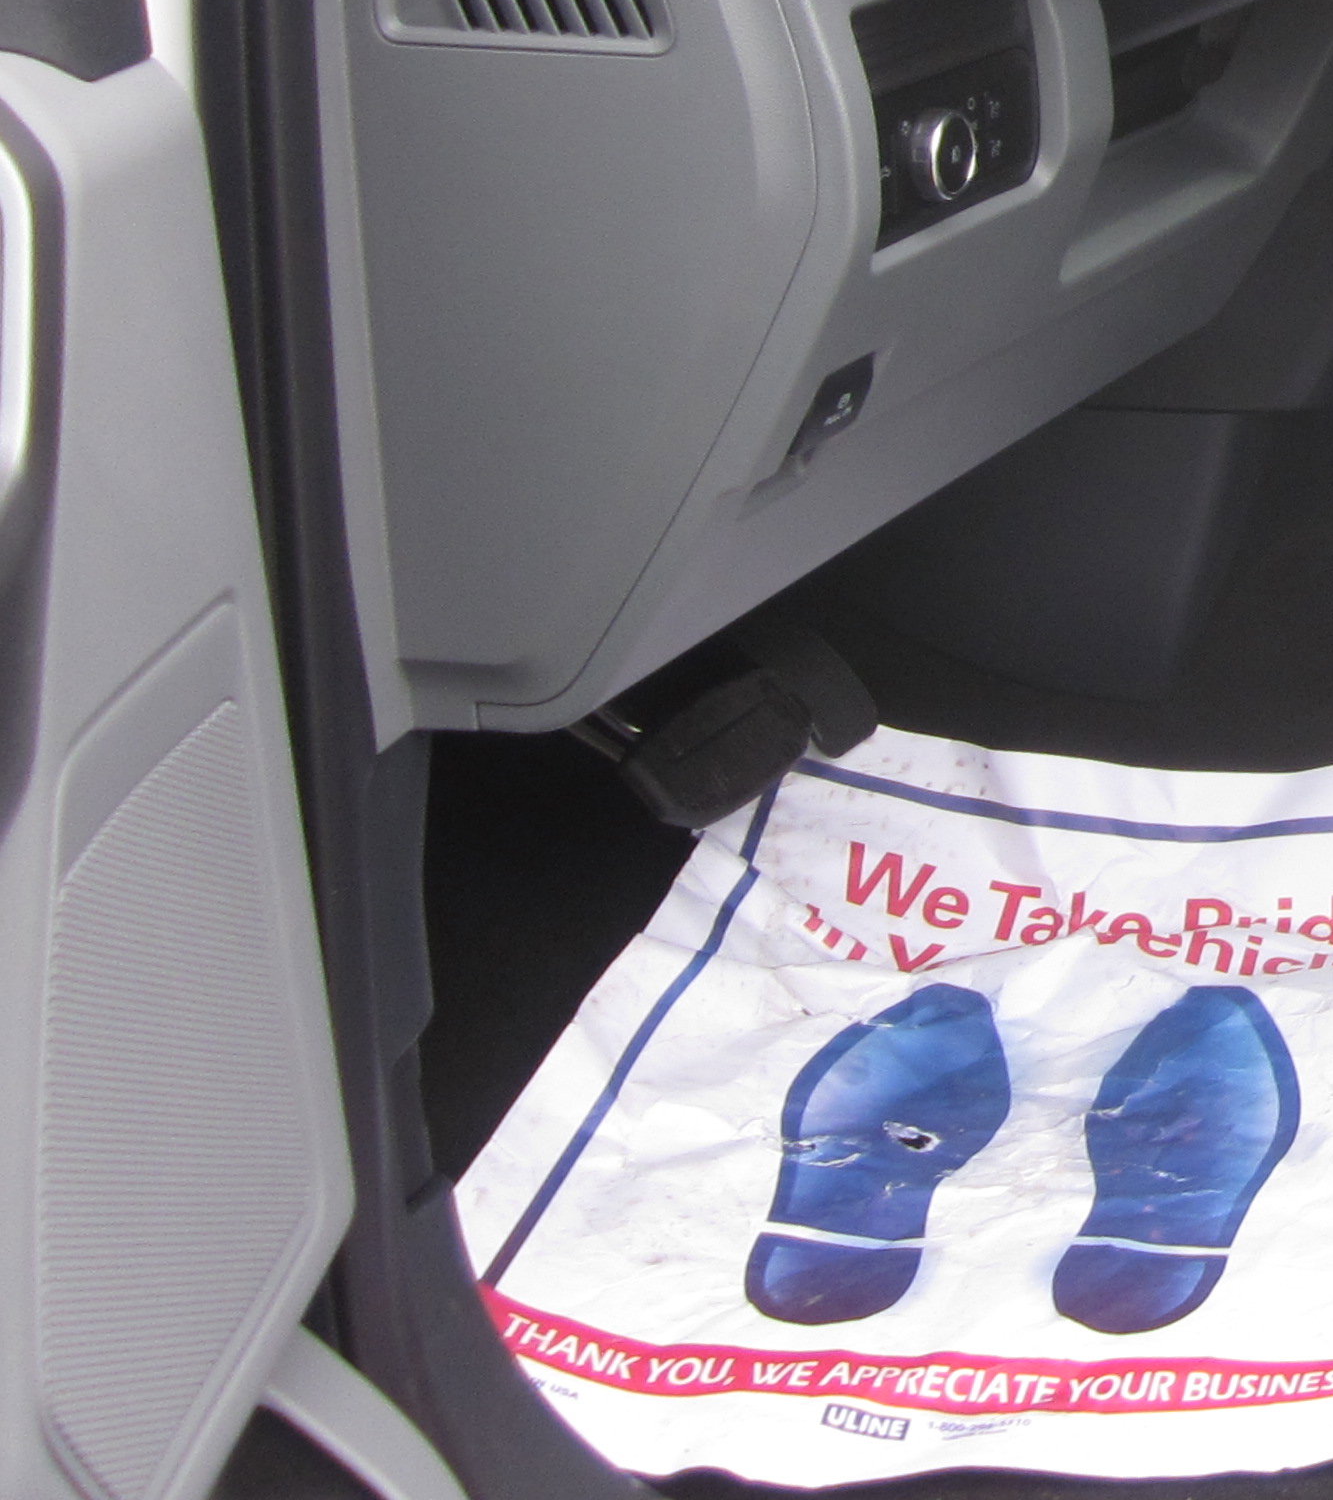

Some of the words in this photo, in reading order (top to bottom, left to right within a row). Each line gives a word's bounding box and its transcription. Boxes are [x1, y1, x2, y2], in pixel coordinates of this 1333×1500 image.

[846, 841, 970, 930] We
[988, 879, 1153, 946] Take
[502, 1312, 643, 1381] THANK
[646, 1356, 737, 1387] YOU,
[752, 1360, 820, 1387] WE
[818, 1361, 1061, 1405] APPRECIATE
[1067, 1371, 1177, 1404] YOUR
[825, 1405, 907, 1438] ULINE
